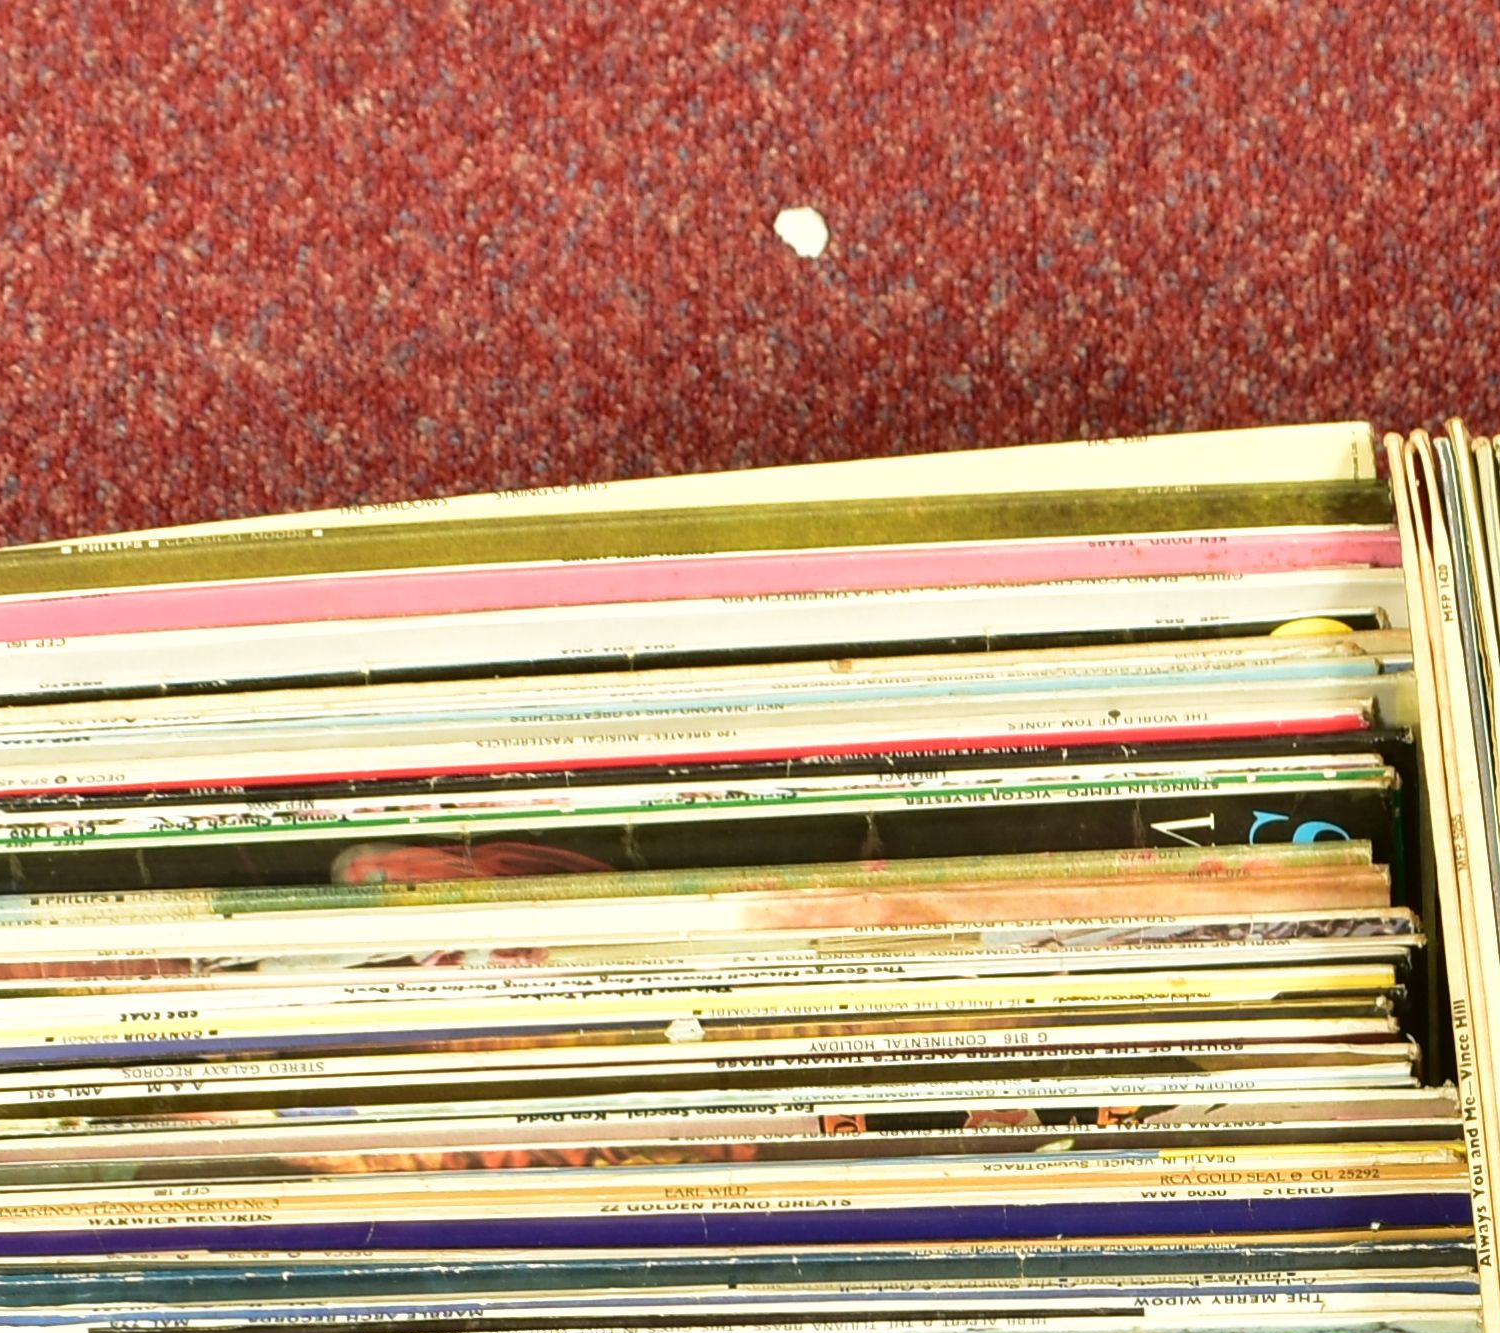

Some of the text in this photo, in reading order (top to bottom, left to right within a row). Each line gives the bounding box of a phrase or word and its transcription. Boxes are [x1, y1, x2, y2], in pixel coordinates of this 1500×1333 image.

[1438, 564, 1454, 622] MFP 1420
[1452, 999, 1469, 1029] Hill
[122, 1032, 1047, 1079] G 816 CONTINENTAL HOLIDAY STEREO GALAXY RECORDS
[1465, 1126, 1481, 1158] and
[1471, 1164, 1487, 1199] You
[1474, 1205, 1494, 1268] Always
[1133, 1293, 1322, 1306] THE MERRY WIDOW
